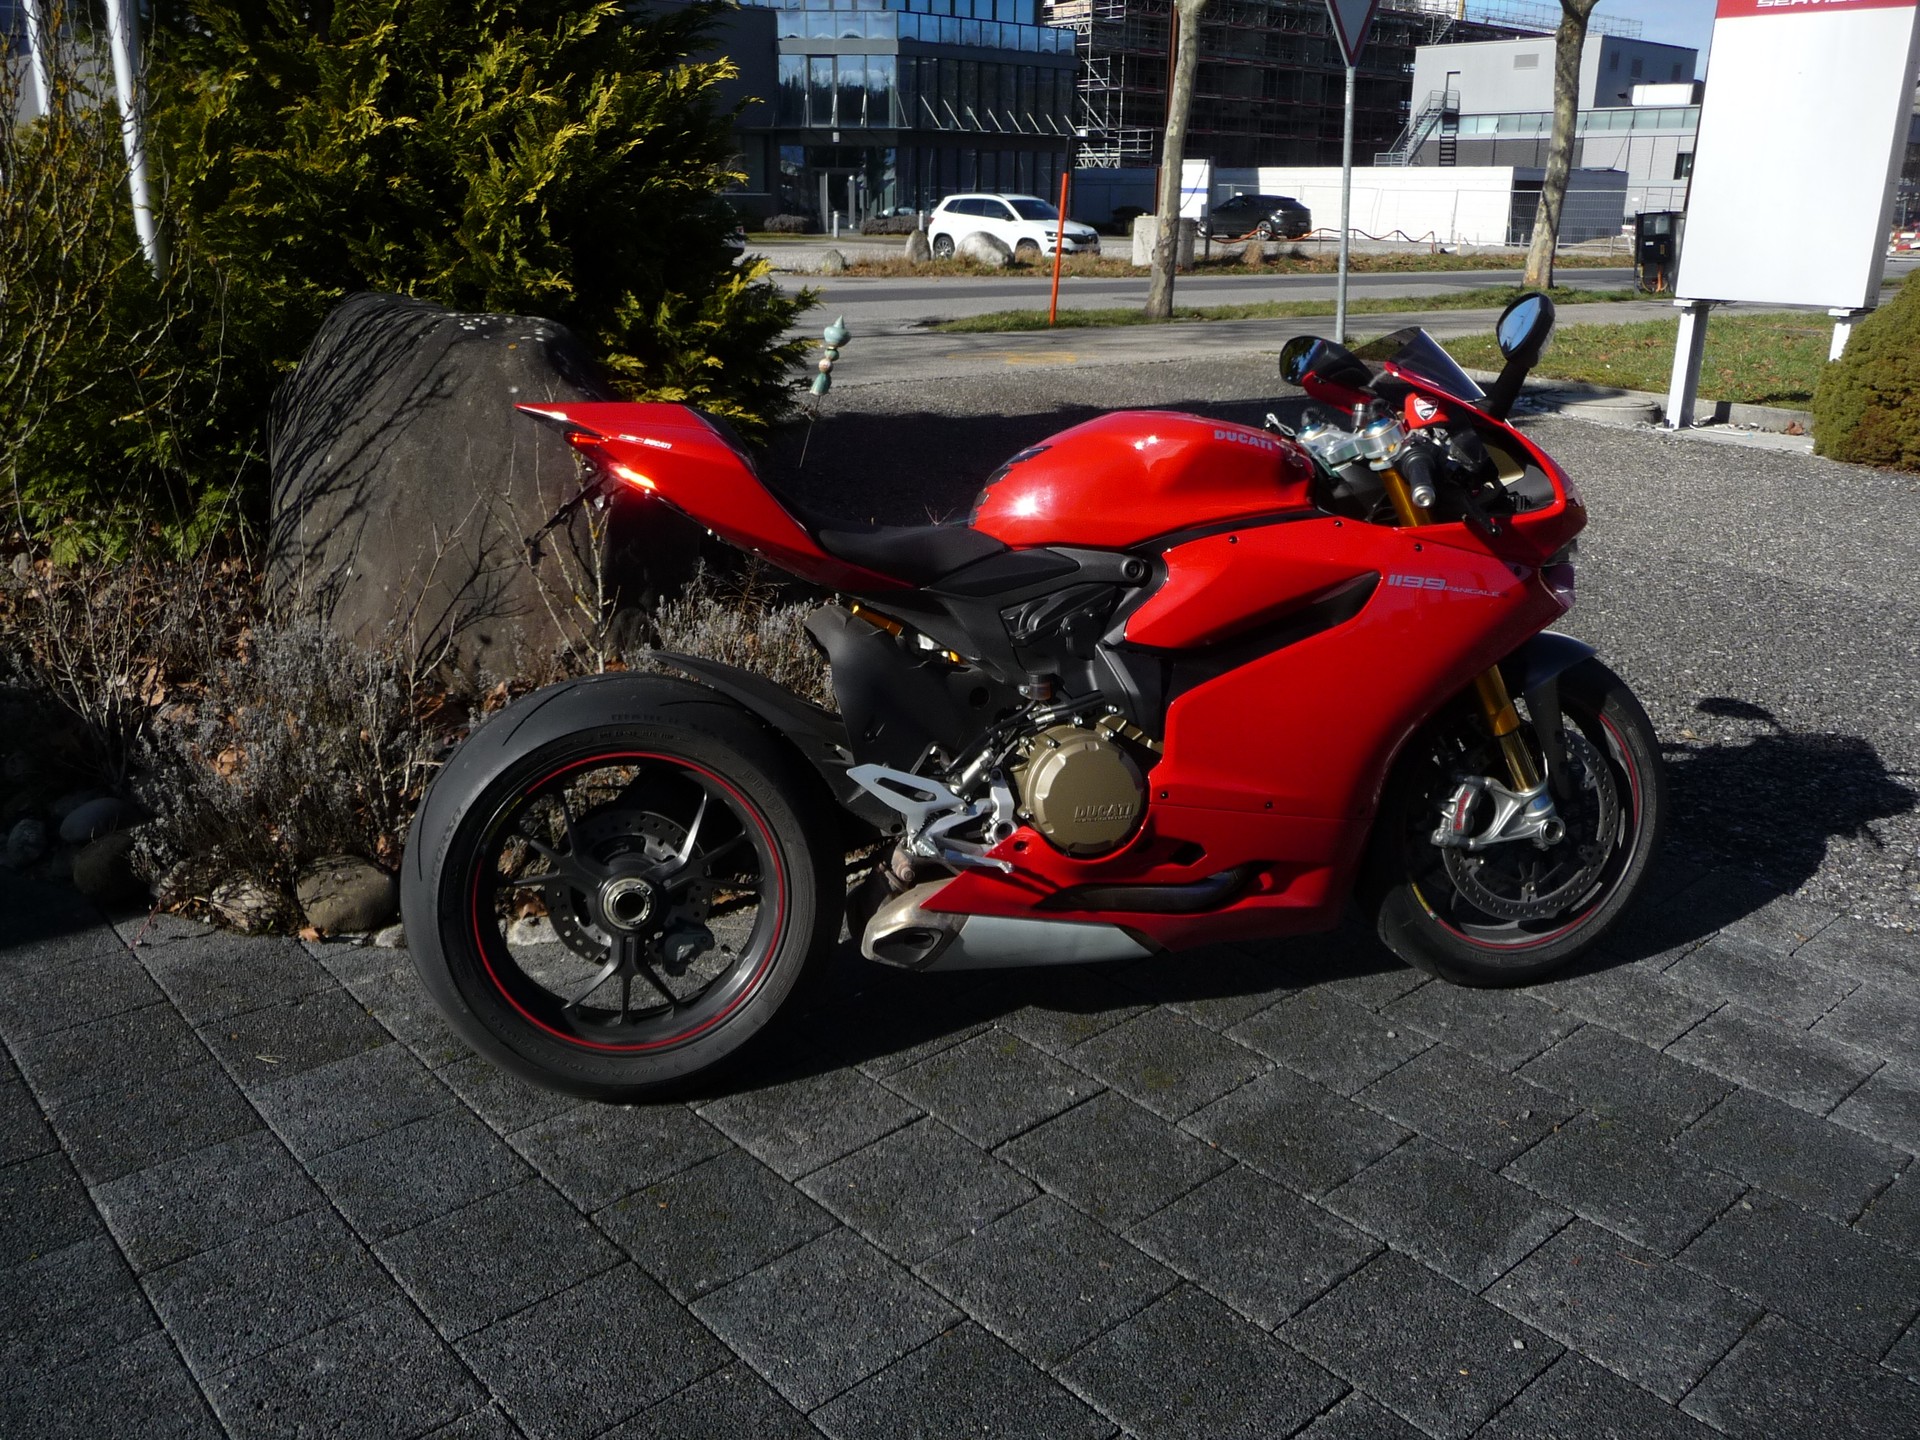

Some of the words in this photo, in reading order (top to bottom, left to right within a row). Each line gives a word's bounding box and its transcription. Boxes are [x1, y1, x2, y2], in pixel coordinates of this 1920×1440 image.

[1214, 429, 1273, 451] DUCATI
[1387, 574, 1447, 591] 1199
[1074, 803, 1134, 819] DUCATI
